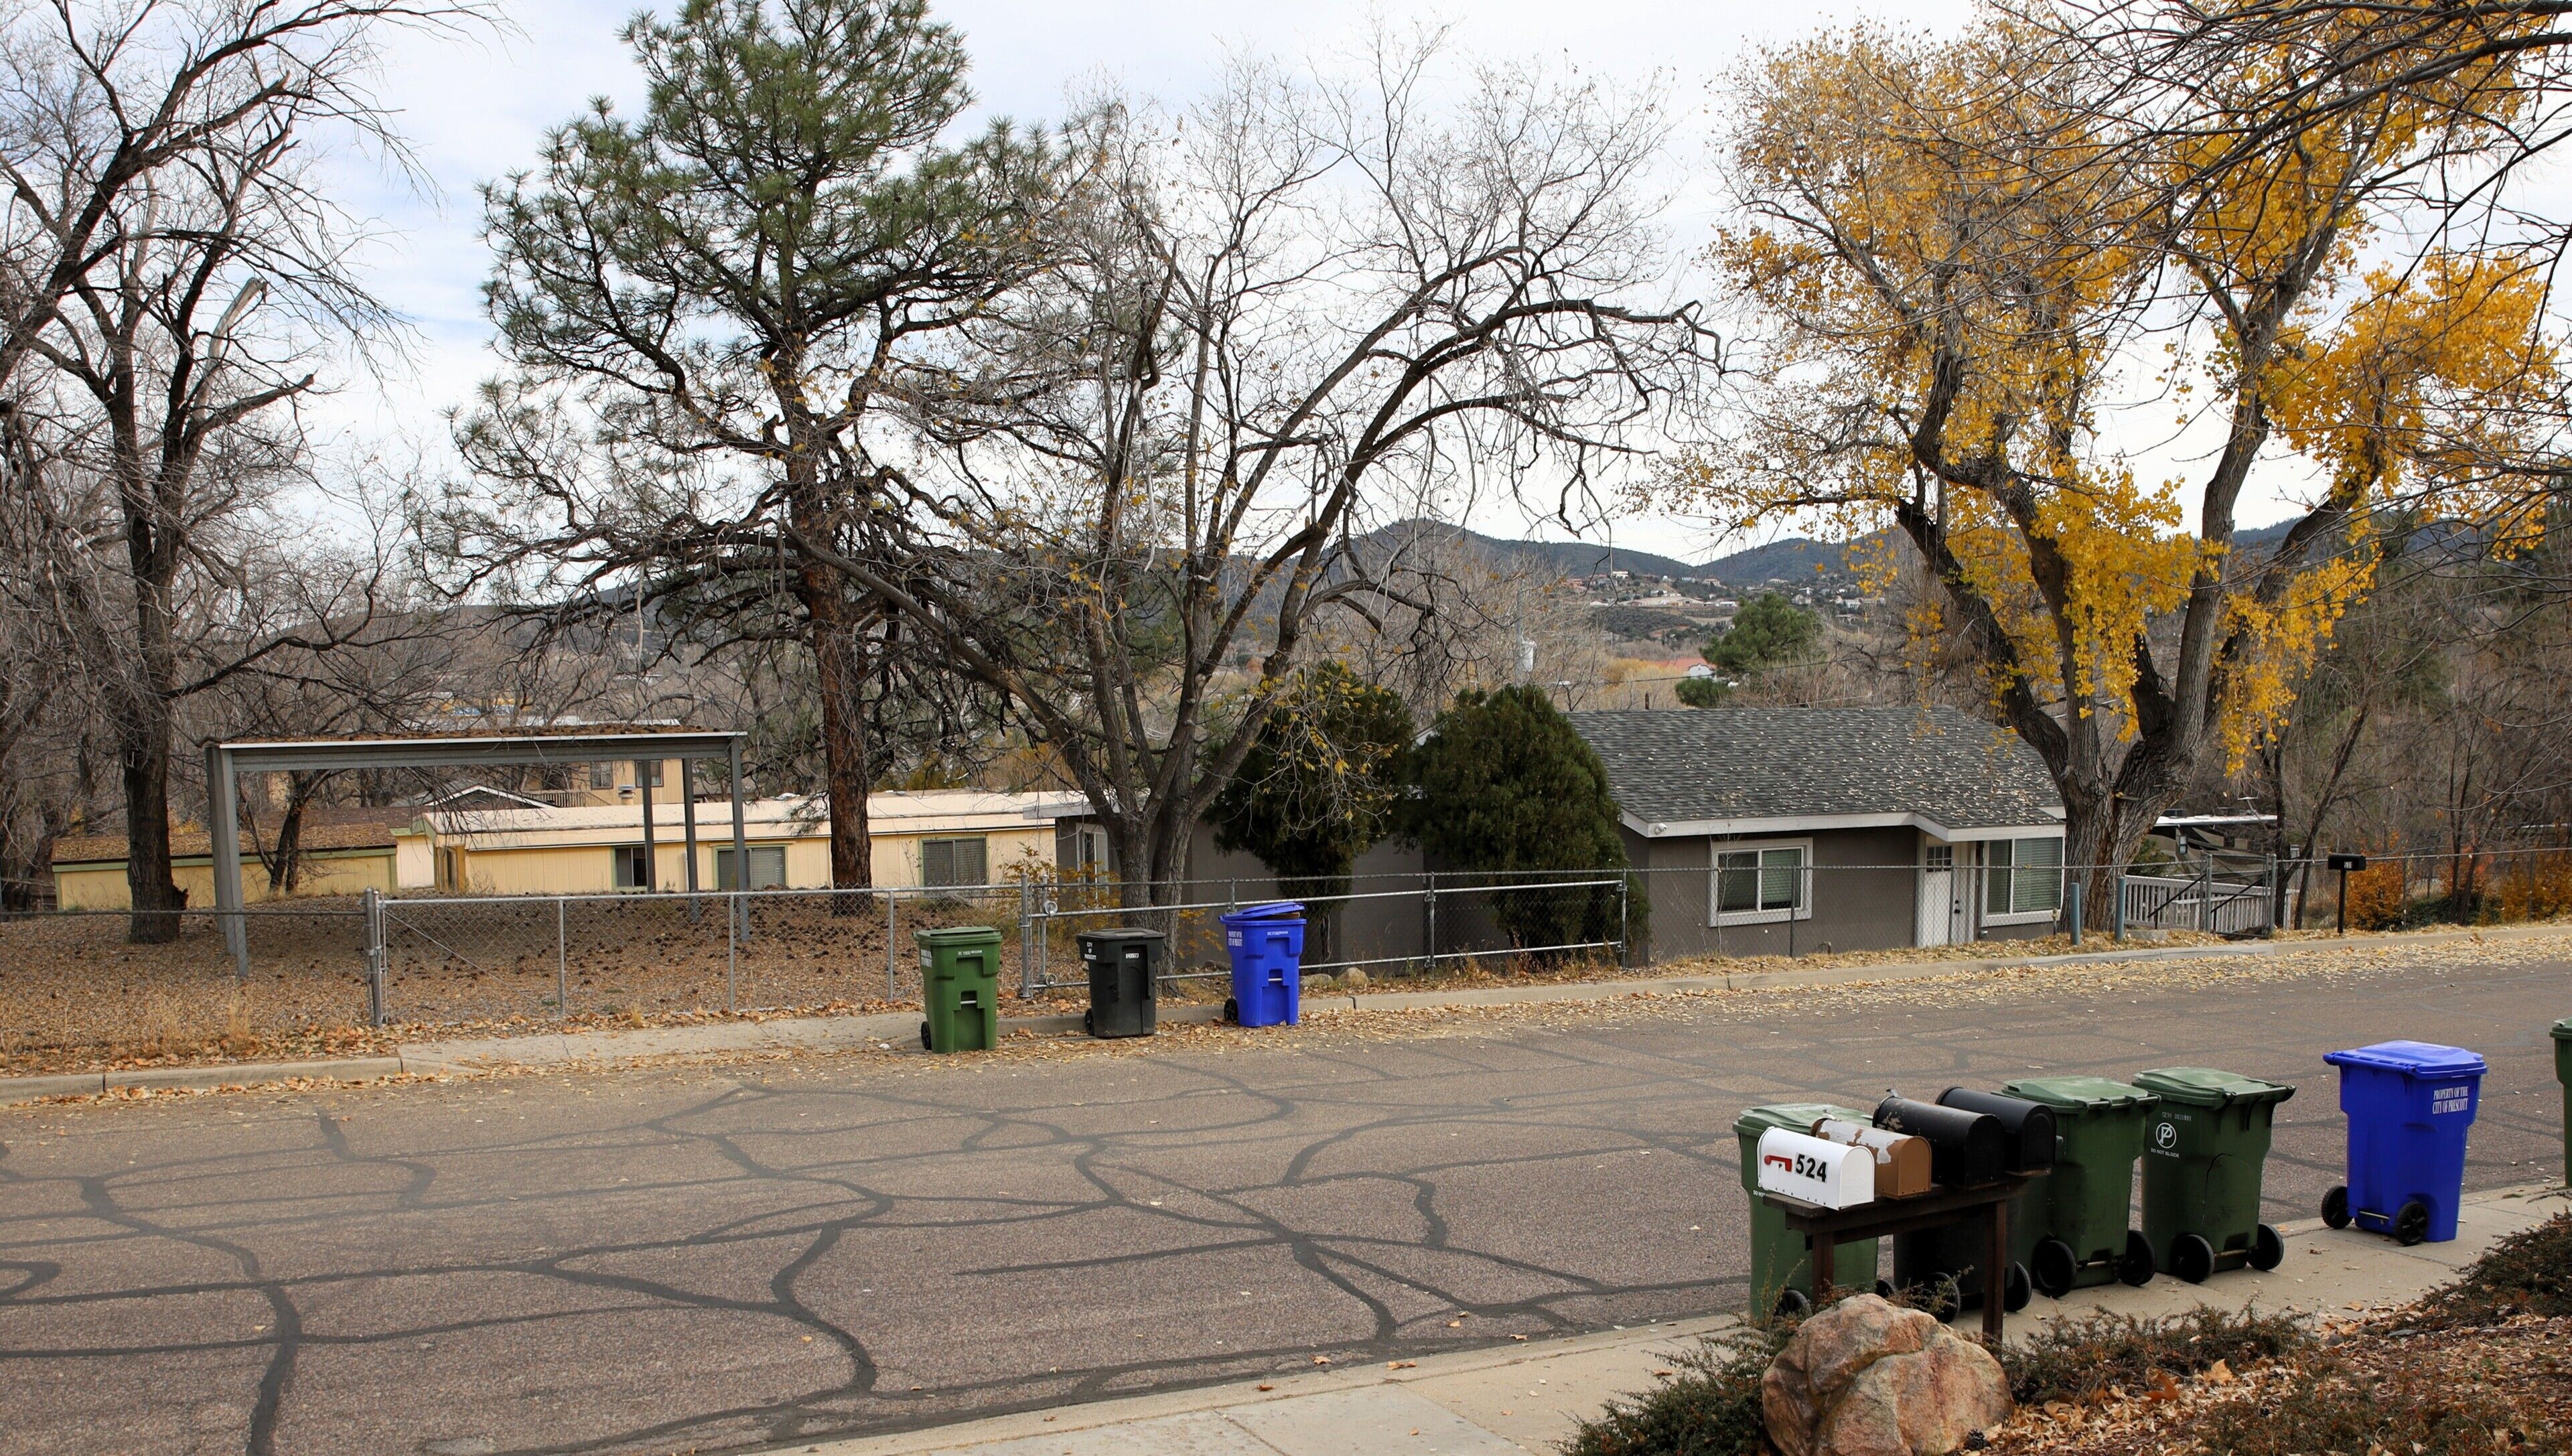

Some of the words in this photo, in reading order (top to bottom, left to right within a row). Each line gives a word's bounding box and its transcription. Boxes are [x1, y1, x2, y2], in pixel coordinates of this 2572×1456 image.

[2433, 1088, 2454, 1100] PROPERTY
[2454, 1087, 2460, 1098] OF
[2460, 1086, 2468, 1097] THE
[2432, 1101, 2443, 1114] CITY
[2443, 1100, 2448, 1113] OF
[2448, 1098, 2468, 1112] PRESCOTT
[2165, 1151, 2180, 1159] BLOCK
[1796, 1153, 1827, 1183] 524
